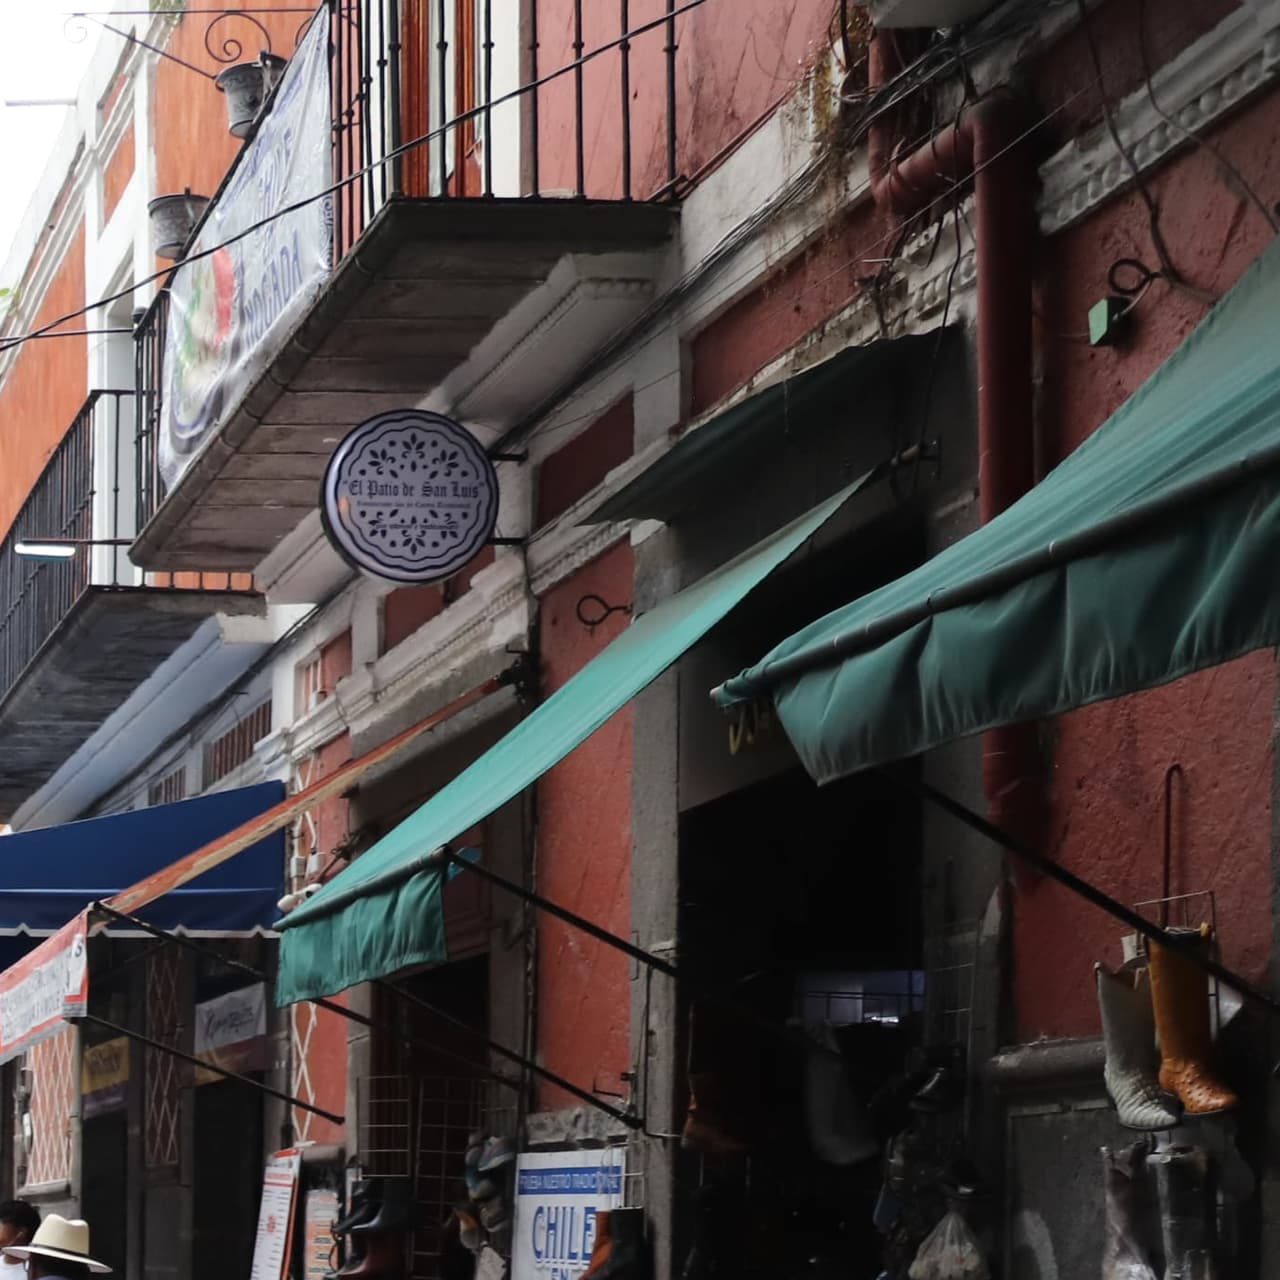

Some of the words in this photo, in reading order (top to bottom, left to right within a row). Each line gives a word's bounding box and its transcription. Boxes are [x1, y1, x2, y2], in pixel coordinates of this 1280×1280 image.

[367, 480, 399, 499] Patio
[403, 482, 415, 496] de
[421, 481, 447, 497] San
[532, 1206, 597, 1260] CHILE
